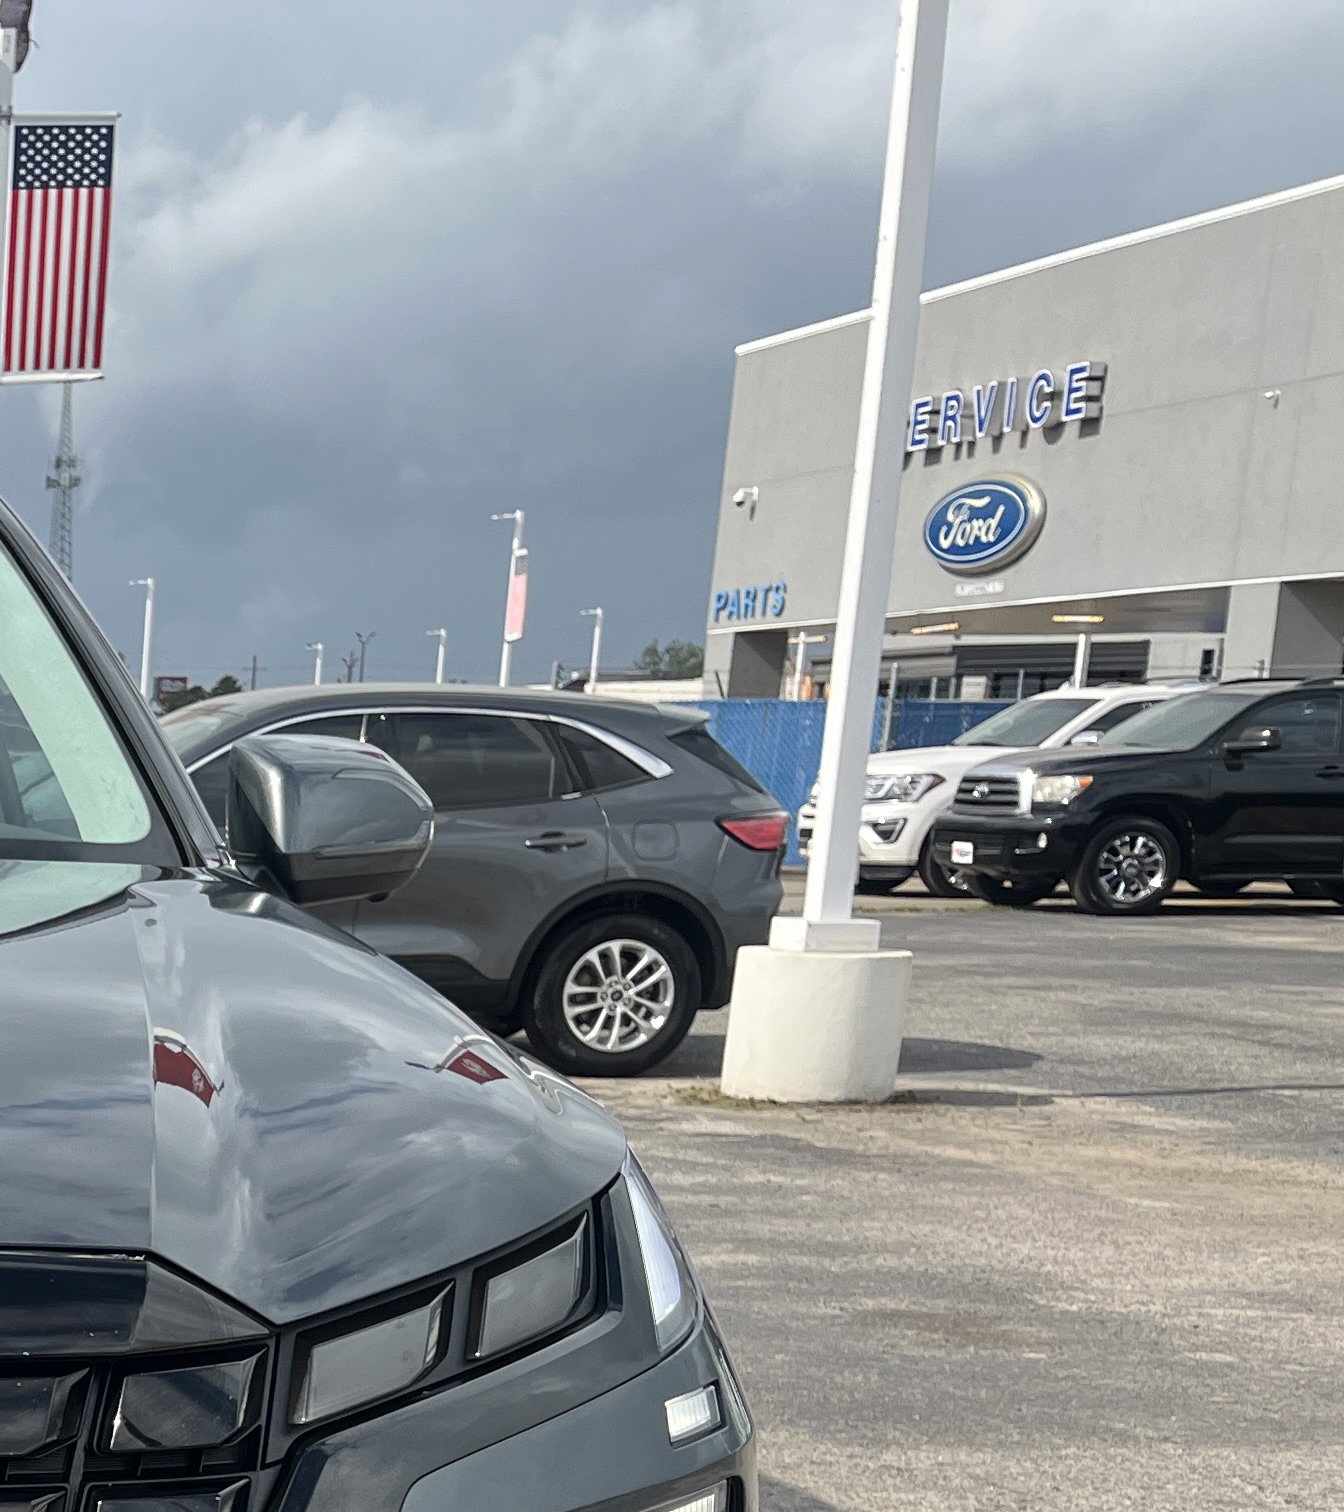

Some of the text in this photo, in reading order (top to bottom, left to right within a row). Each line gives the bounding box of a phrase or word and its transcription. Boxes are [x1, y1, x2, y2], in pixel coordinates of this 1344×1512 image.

[907, 361, 1091, 452] ERVICE
[939, 495, 1006, 550] Ford
[713, 580, 787, 623] PARTS
